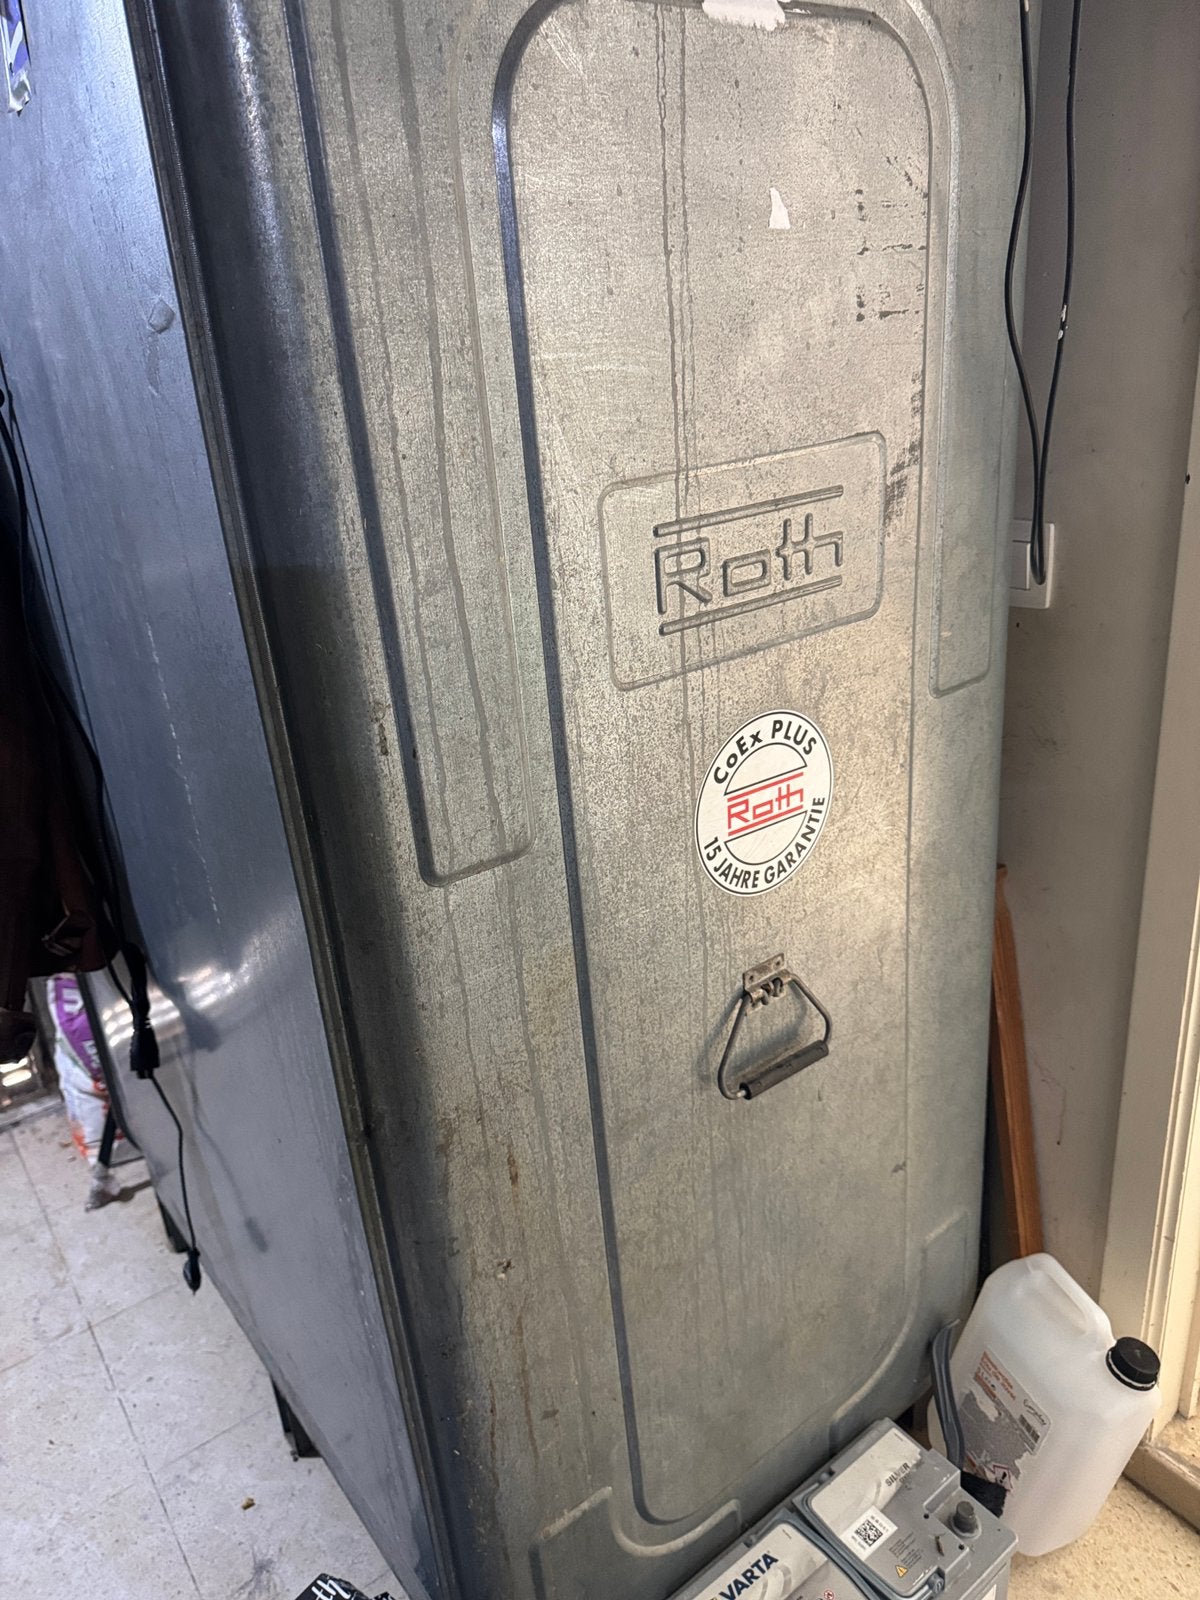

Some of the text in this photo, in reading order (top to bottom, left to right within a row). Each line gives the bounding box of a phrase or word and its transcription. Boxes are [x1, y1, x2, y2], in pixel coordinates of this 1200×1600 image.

[654, 511, 844, 616] Roth
[771, 719, 817, 755] PLUS
[727, 783, 804, 830] Roth
[703, 797, 826, 889] 15 JAHRE GARANTIE
[885, 1463, 910, 1487] SILVER
[719, 1553, 779, 1600] VARTA
